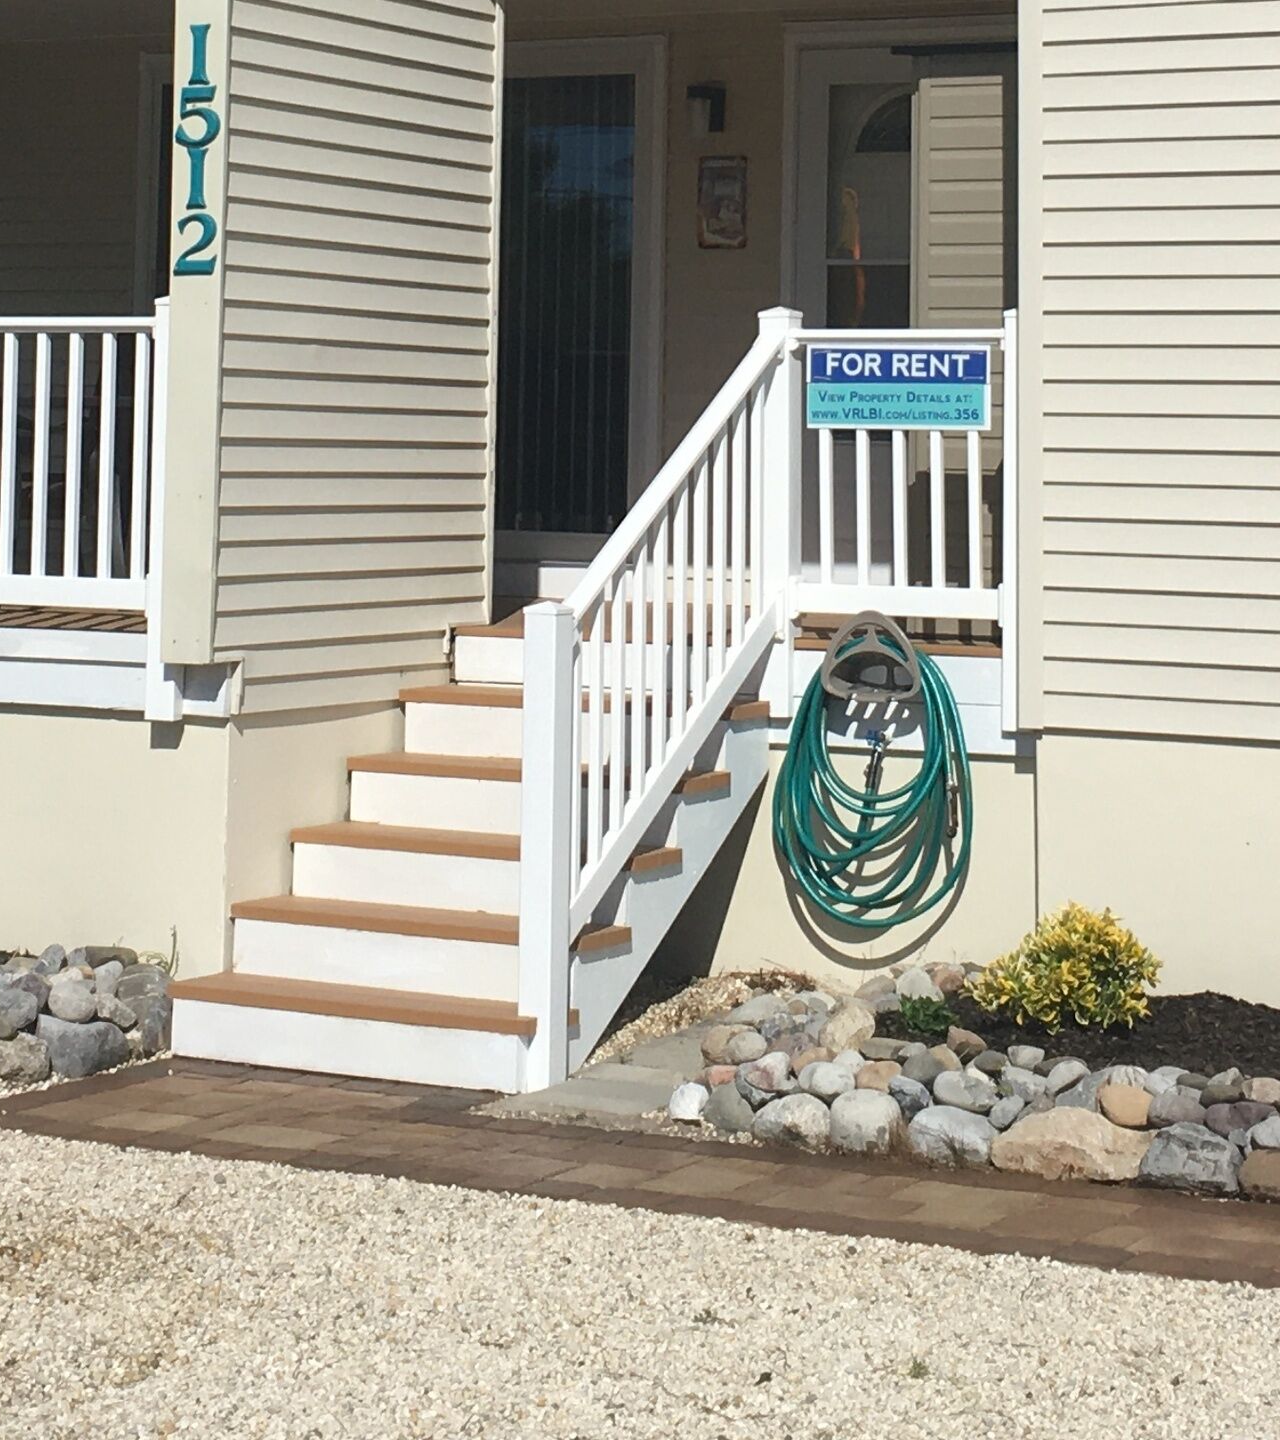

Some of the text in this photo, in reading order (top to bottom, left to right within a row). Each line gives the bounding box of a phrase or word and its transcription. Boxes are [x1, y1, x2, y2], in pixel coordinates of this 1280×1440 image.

[173, 24, 221, 276] 1512
[825, 352, 971, 378] FOR RENT
